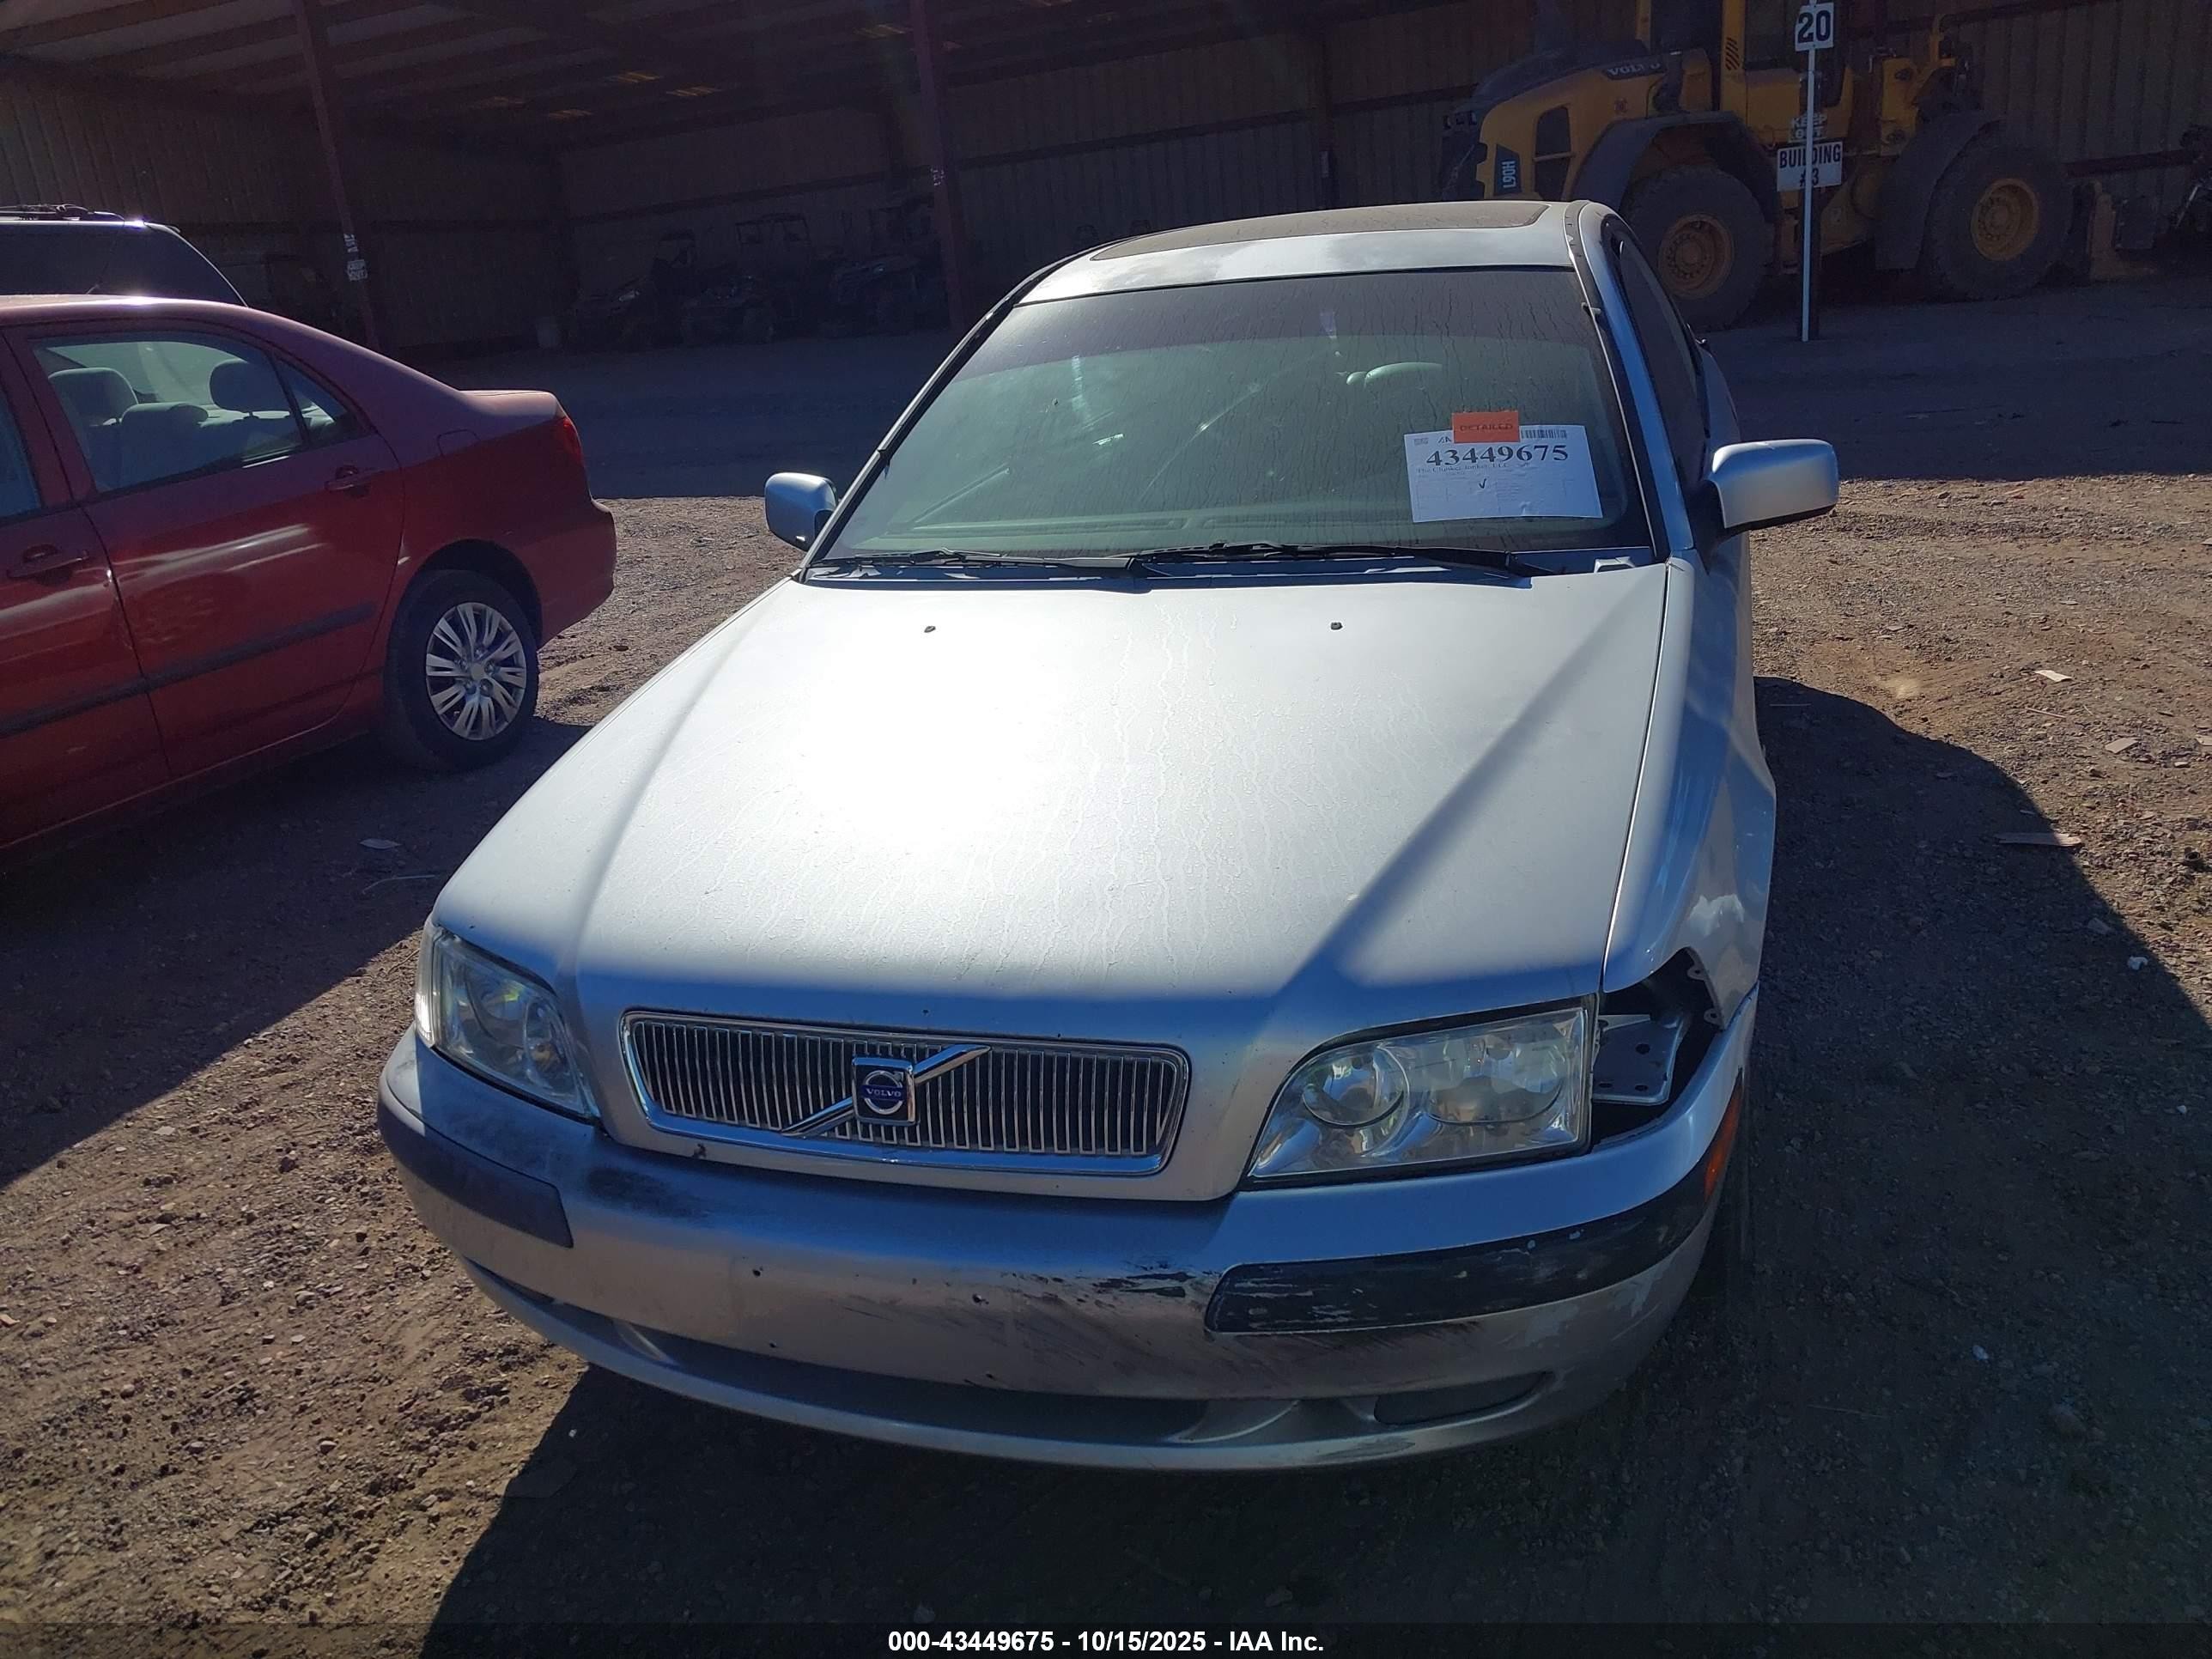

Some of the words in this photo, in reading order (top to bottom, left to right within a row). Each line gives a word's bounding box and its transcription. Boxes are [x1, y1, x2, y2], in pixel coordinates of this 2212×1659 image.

[1797, 9, 1831, 43] 20
[1607, 62, 1661, 76] VOLO
[1796, 126, 1824, 138] OT
[1779, 143, 1841, 168] BUILDING
[1502, 161, 1516, 188] L90H
[1460, 422, 1514, 431] DETAILED
[1426, 444, 1569, 465] 43449675
[866, 1088, 902, 1097] VOLVO
